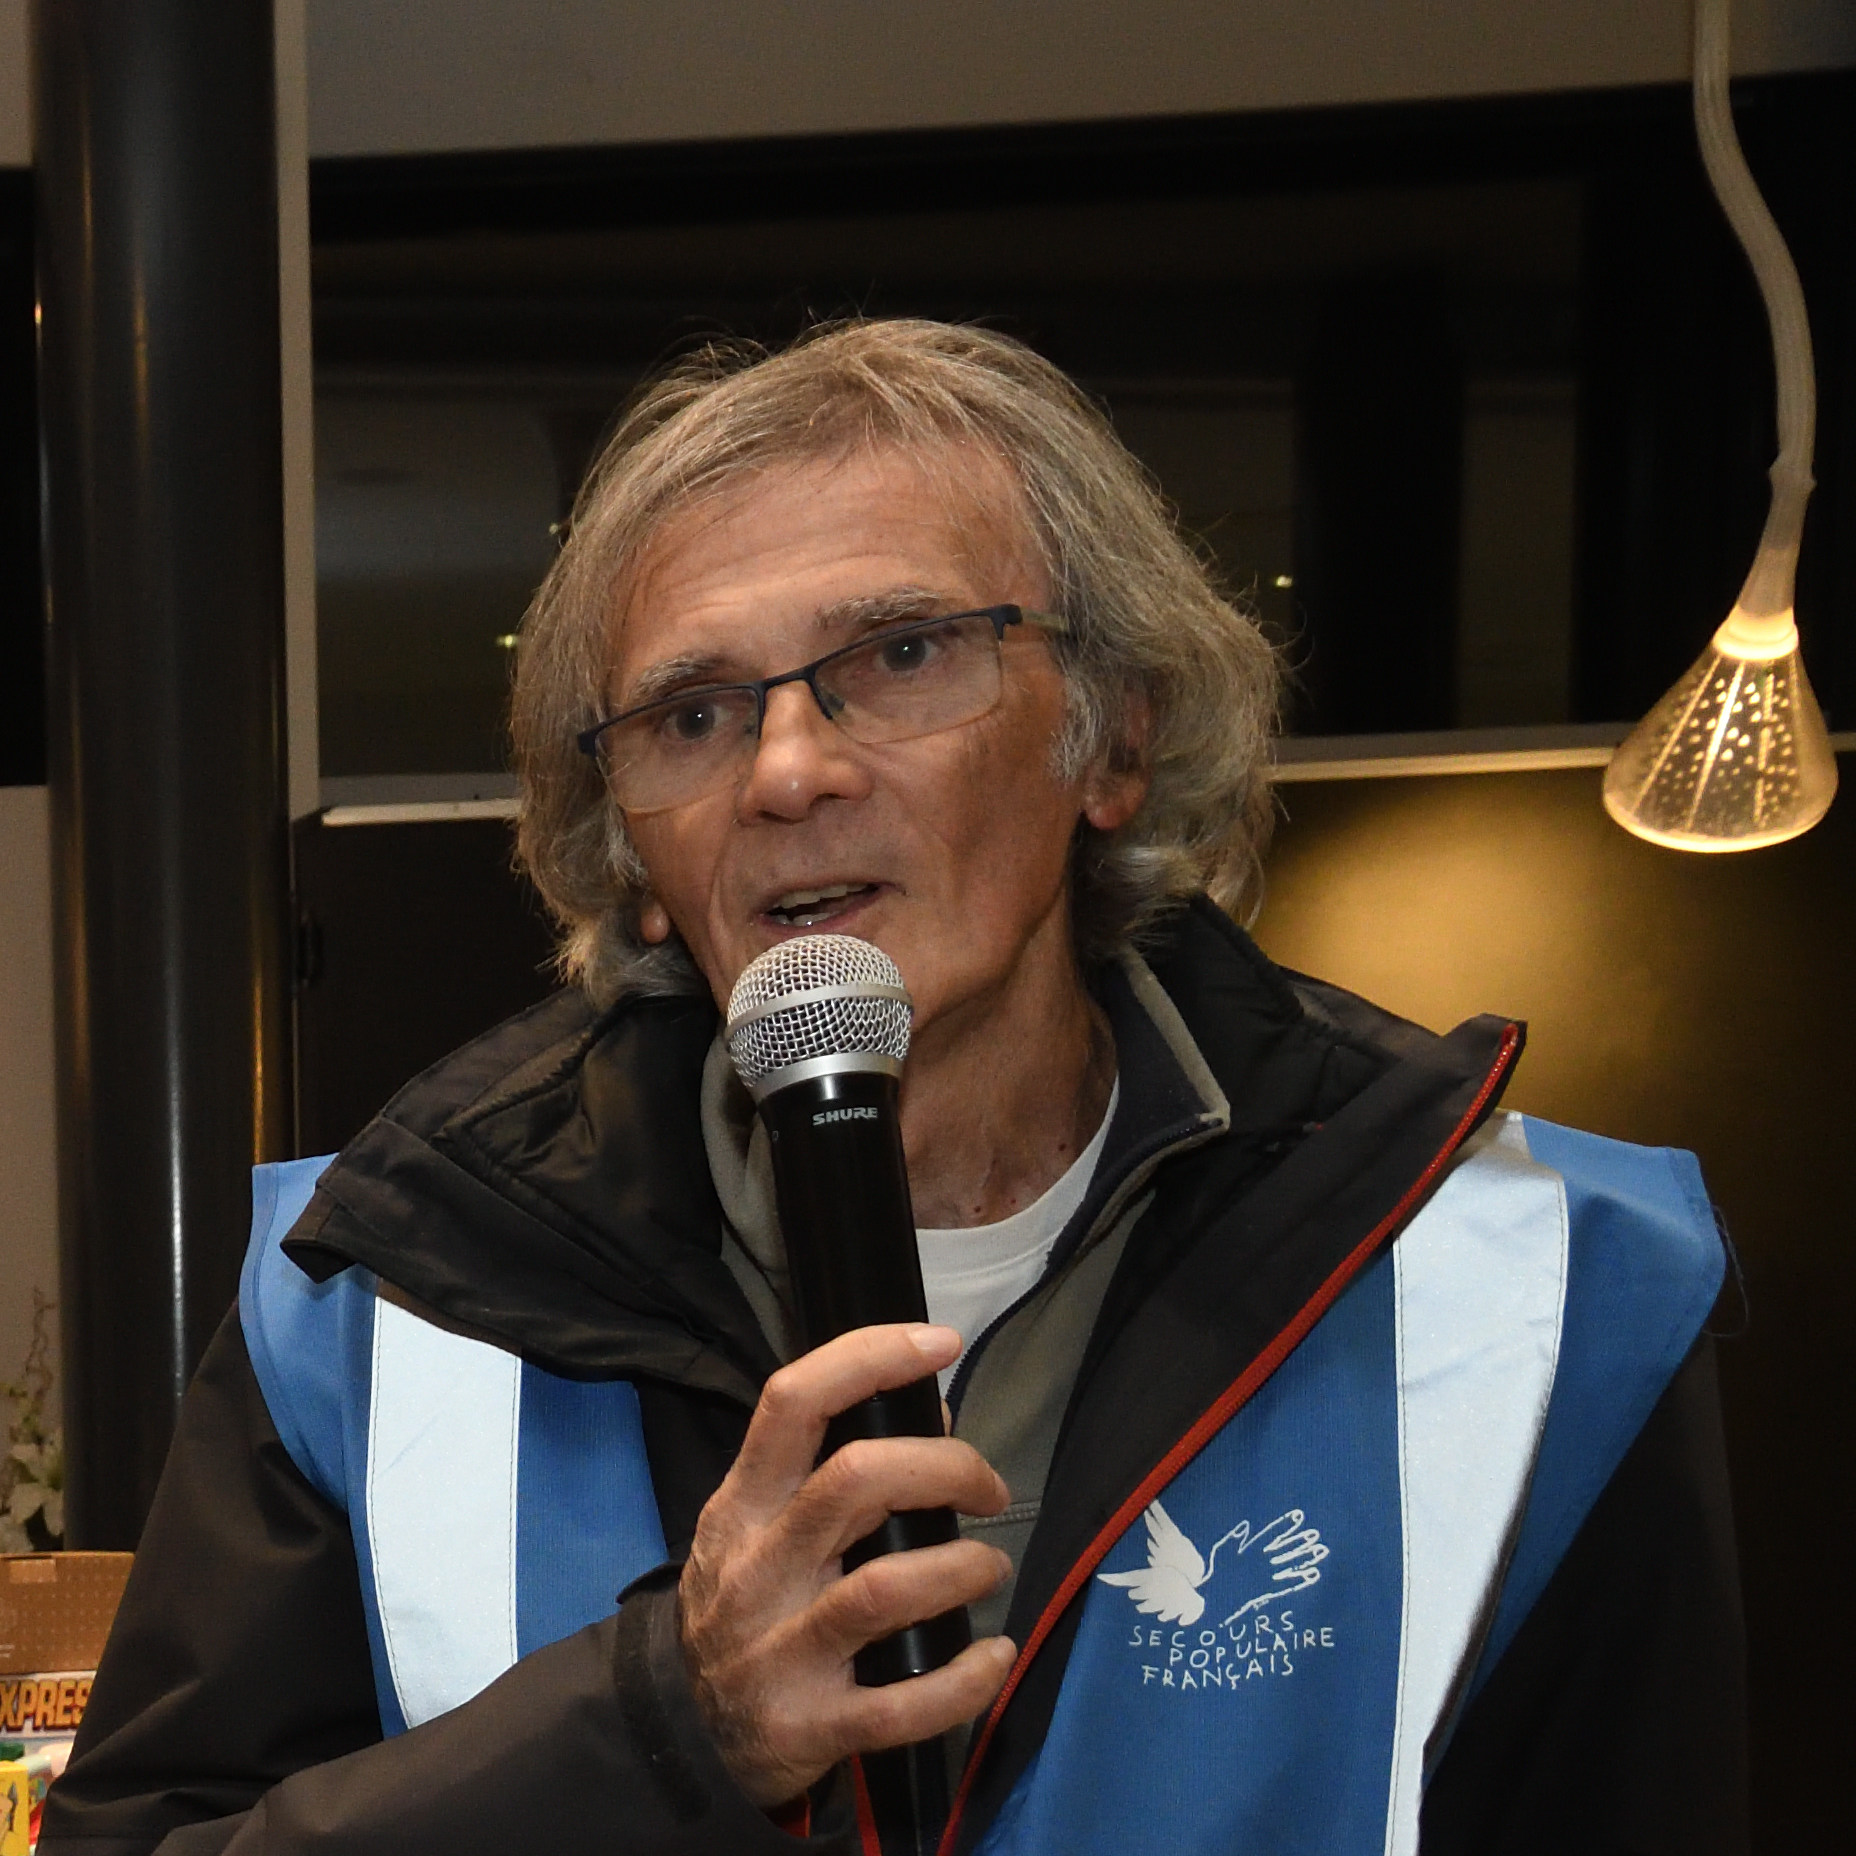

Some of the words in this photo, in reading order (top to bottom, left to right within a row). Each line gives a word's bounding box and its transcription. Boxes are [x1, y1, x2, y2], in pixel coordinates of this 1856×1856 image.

[812, 1107, 878, 1126] SHURE
[1129, 1611, 1294, 1647] SECOURS
[1169, 1627, 1335, 1668] POPULAIRE
[1141, 1654, 1294, 1690] FRANÇAIS
